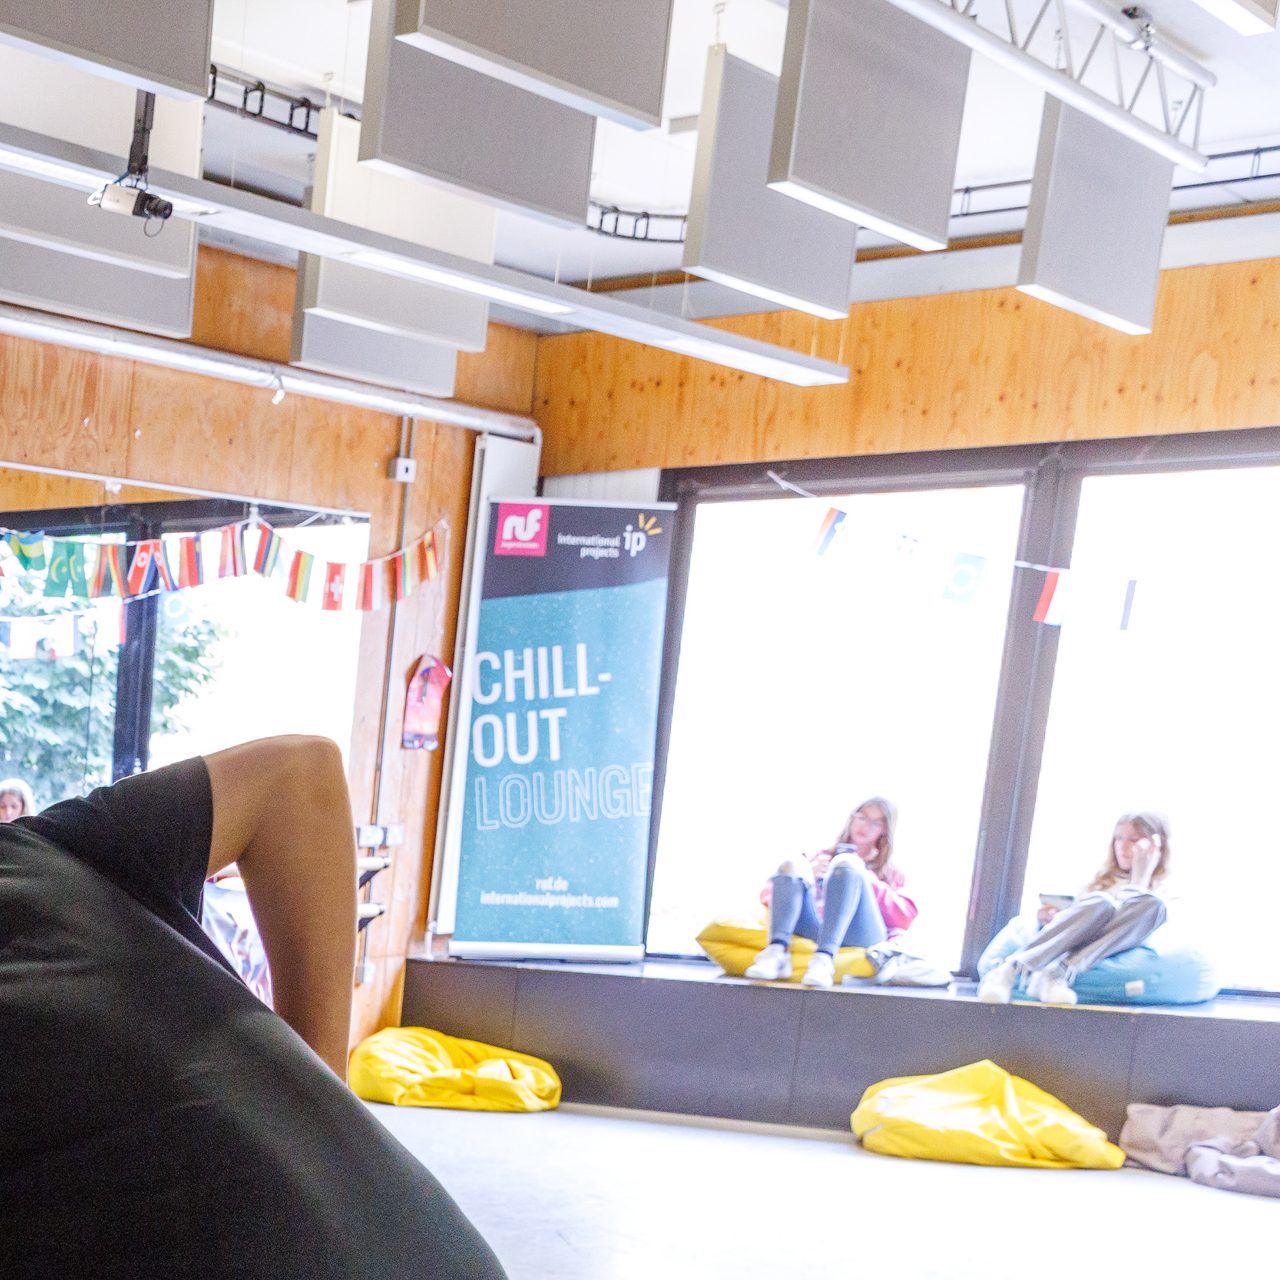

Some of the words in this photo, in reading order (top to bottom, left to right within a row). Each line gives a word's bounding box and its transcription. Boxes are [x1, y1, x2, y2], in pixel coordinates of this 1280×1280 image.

[557, 532, 621, 546] international
[579, 547, 620, 560] projects
[623, 524, 646, 557] ip
[472, 643, 612, 705] CHILL-
[472, 708, 568, 768] OUT
[474, 762, 653, 831] LOUNGE
[480, 890, 620, 909] internationalprojects.com
